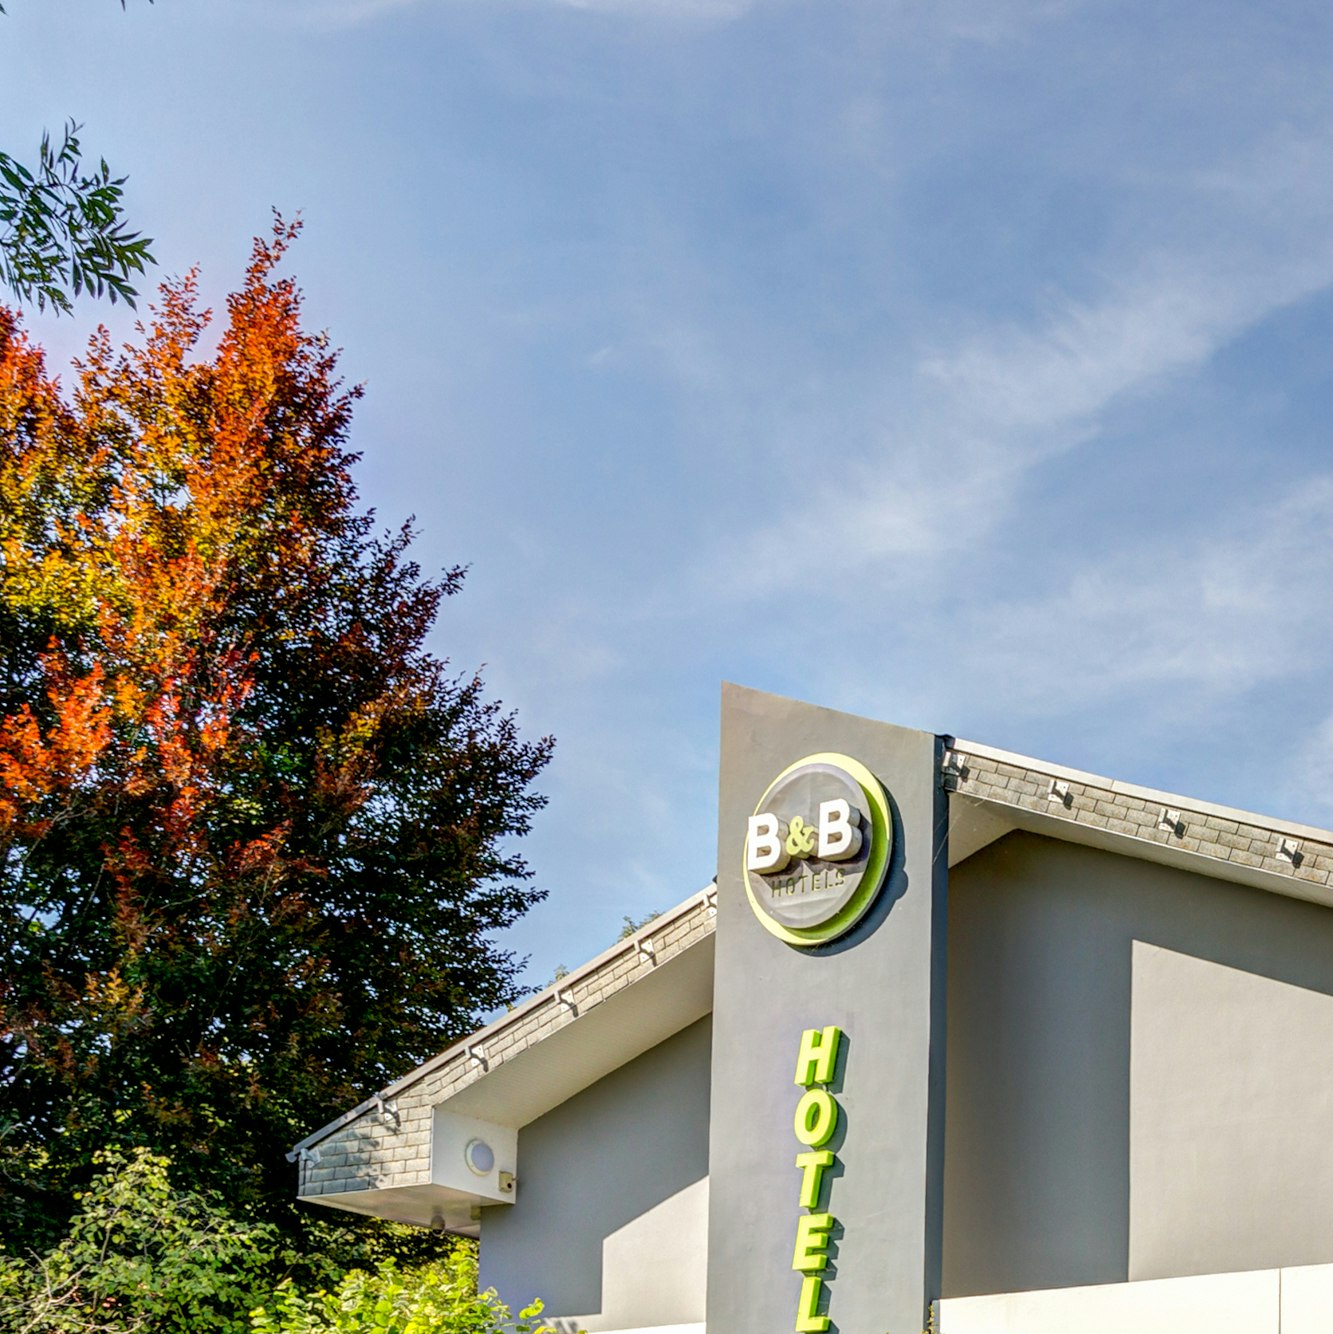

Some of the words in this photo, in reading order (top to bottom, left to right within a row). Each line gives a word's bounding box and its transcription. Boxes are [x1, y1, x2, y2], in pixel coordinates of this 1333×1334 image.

[748, 798, 852, 870] B&B
[771, 868, 845, 898] HOTELS
[792, 1025, 841, 1333] HOTEL
